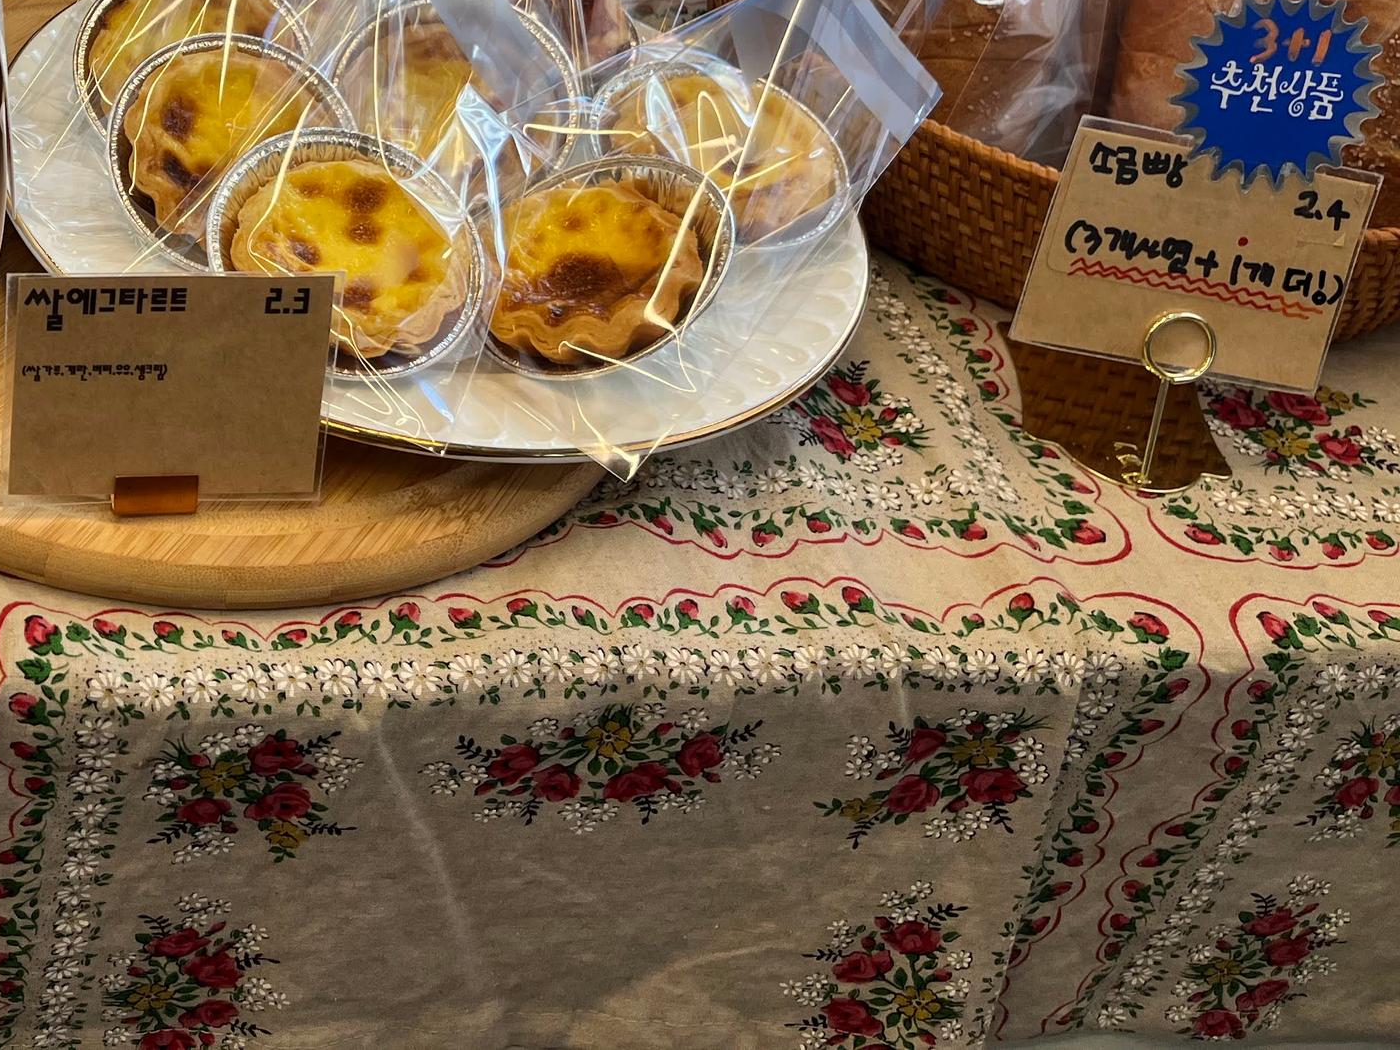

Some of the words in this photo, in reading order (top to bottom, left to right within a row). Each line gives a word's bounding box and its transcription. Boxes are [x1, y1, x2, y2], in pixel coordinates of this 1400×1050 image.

[1249, 19, 1332, 65] 3+1
[1210, 60, 1344, 121] 추천상품
[1089, 142, 1188, 188] 소금빵
[1294, 190, 1351, 231] 2.4
[24, 287, 188, 331] 쌀에그타르트
[264, 288, 310, 314] 2.3
